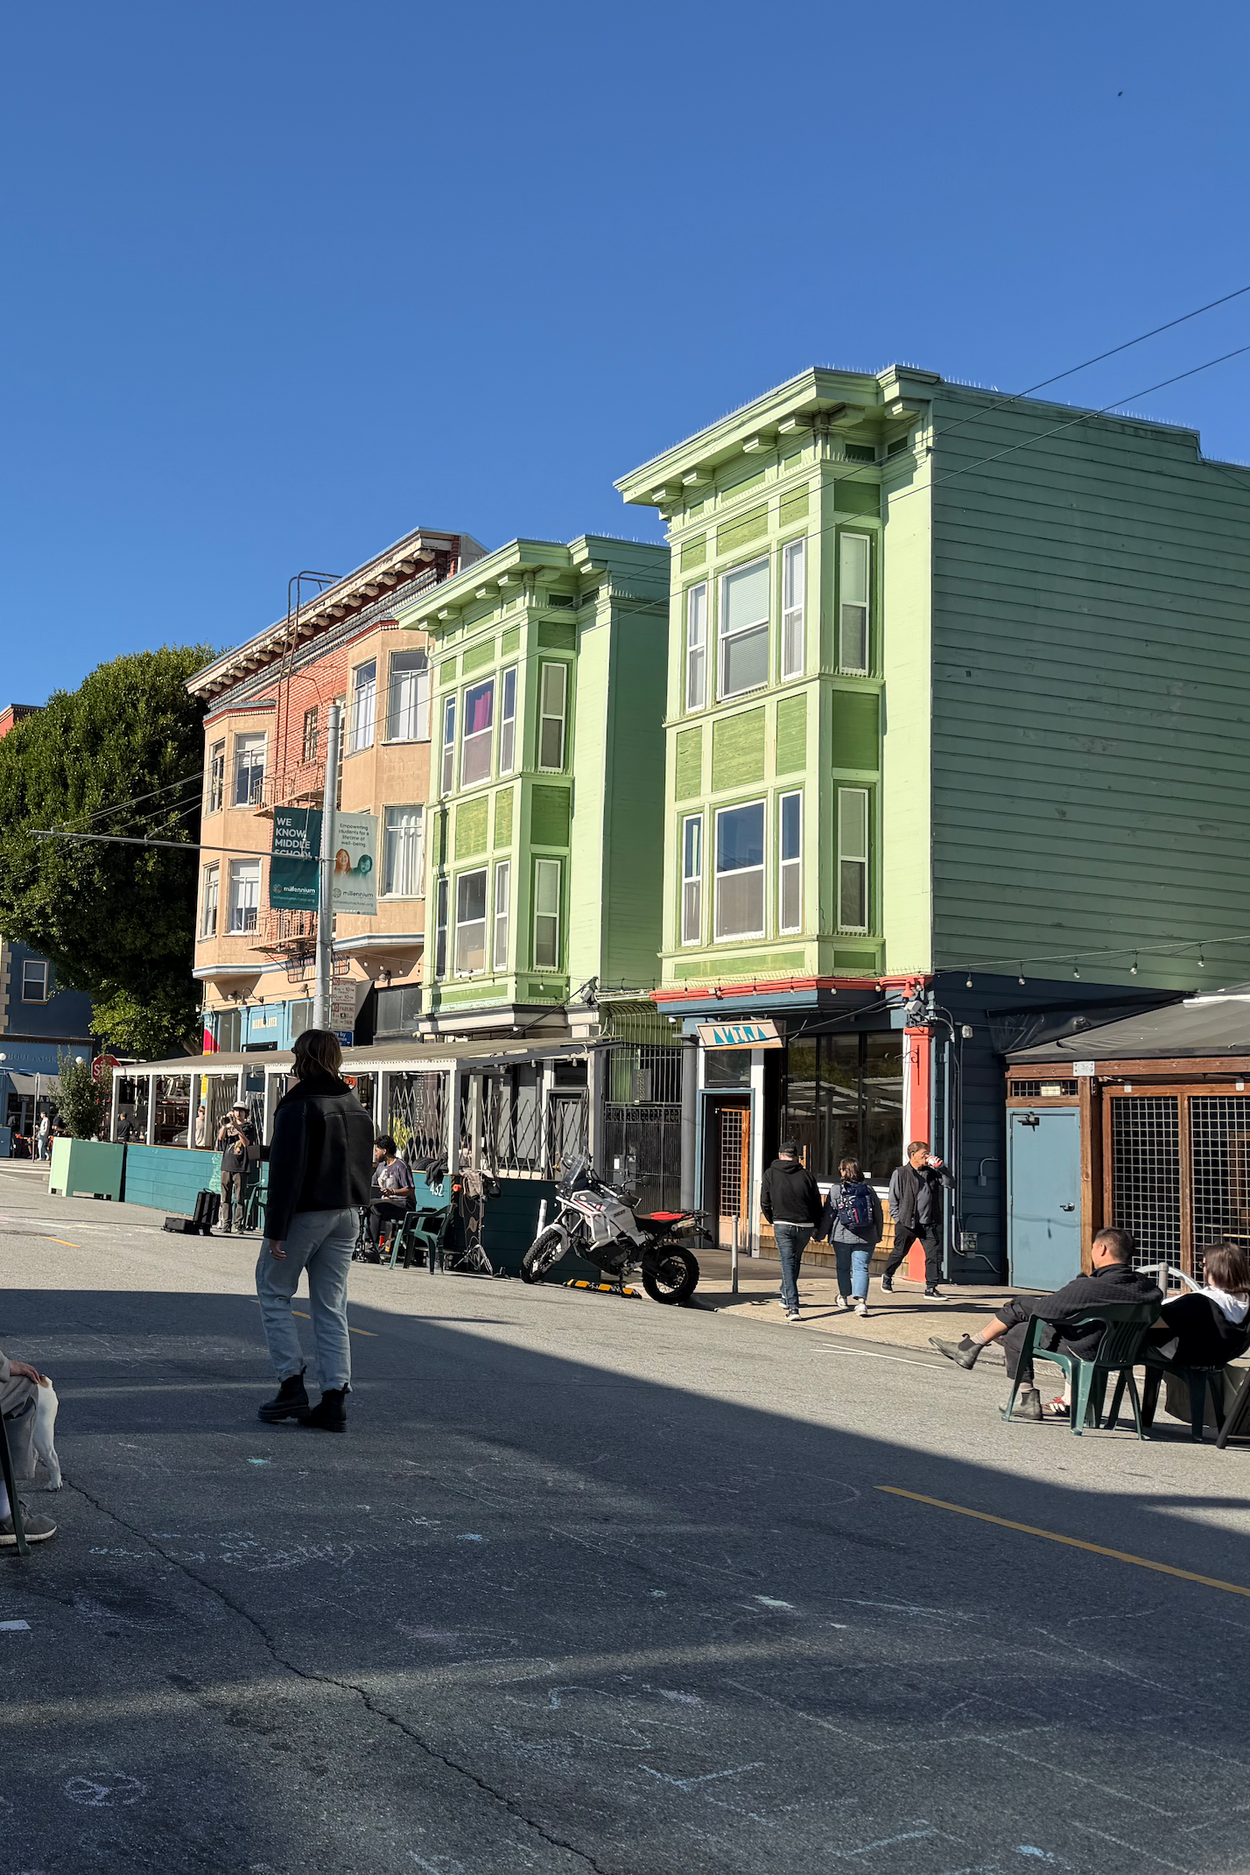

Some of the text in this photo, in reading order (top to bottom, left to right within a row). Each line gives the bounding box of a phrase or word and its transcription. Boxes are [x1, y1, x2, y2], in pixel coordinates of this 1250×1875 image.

[276, 817, 292, 827] WE
[339, 823, 369, 832] Empowering
[275, 828, 306, 838] KNOW
[274, 838, 311, 849] MIDDLE
